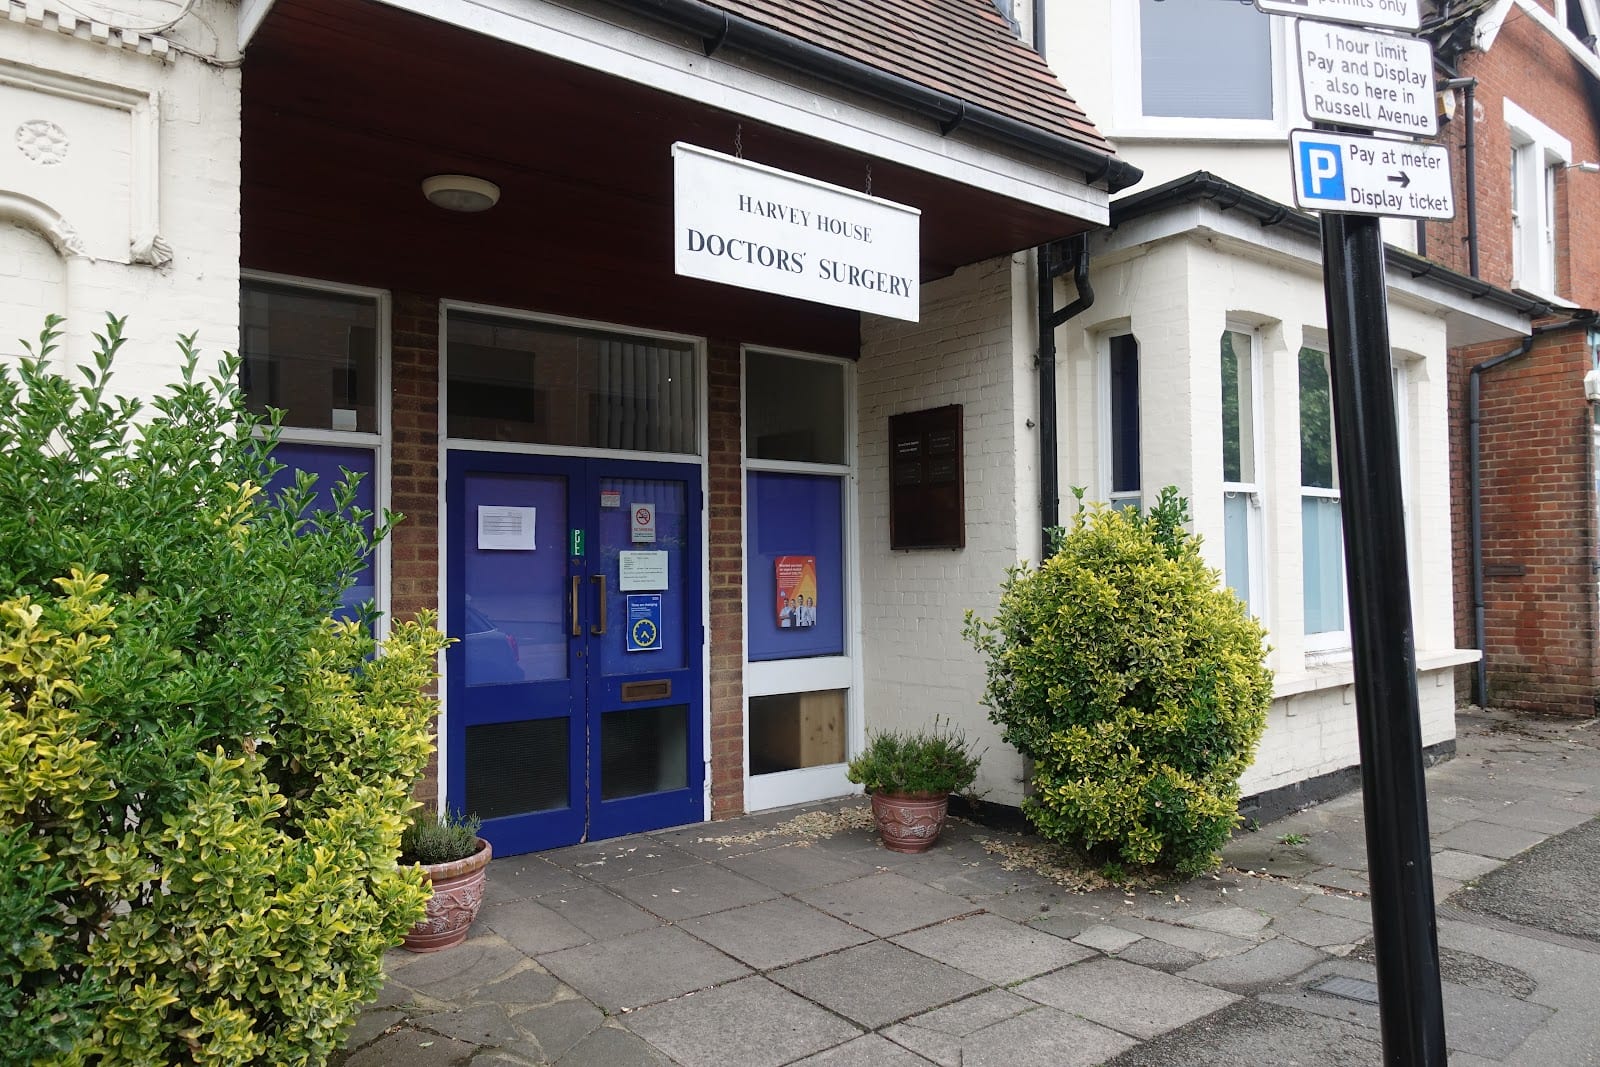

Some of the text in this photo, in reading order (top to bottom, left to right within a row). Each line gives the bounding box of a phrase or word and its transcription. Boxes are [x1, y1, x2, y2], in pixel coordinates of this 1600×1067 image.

[1379, 0, 1407, 16] only
[1325, 32, 1408, 62] 1 hour limit
[1307, 51, 1427, 89] Pay and Display
[1326, 77, 1415, 105] also here in
[1314, 94, 1428, 127] Russell Avenue
[1308, 148, 1337, 194] P
[1349, 144, 1441, 169] Pay at meter
[1350, 187, 1449, 211] Display ticket
[738, 194, 873, 244] HARVEY HOUSE
[818, 258, 913, 298] SURGERY
